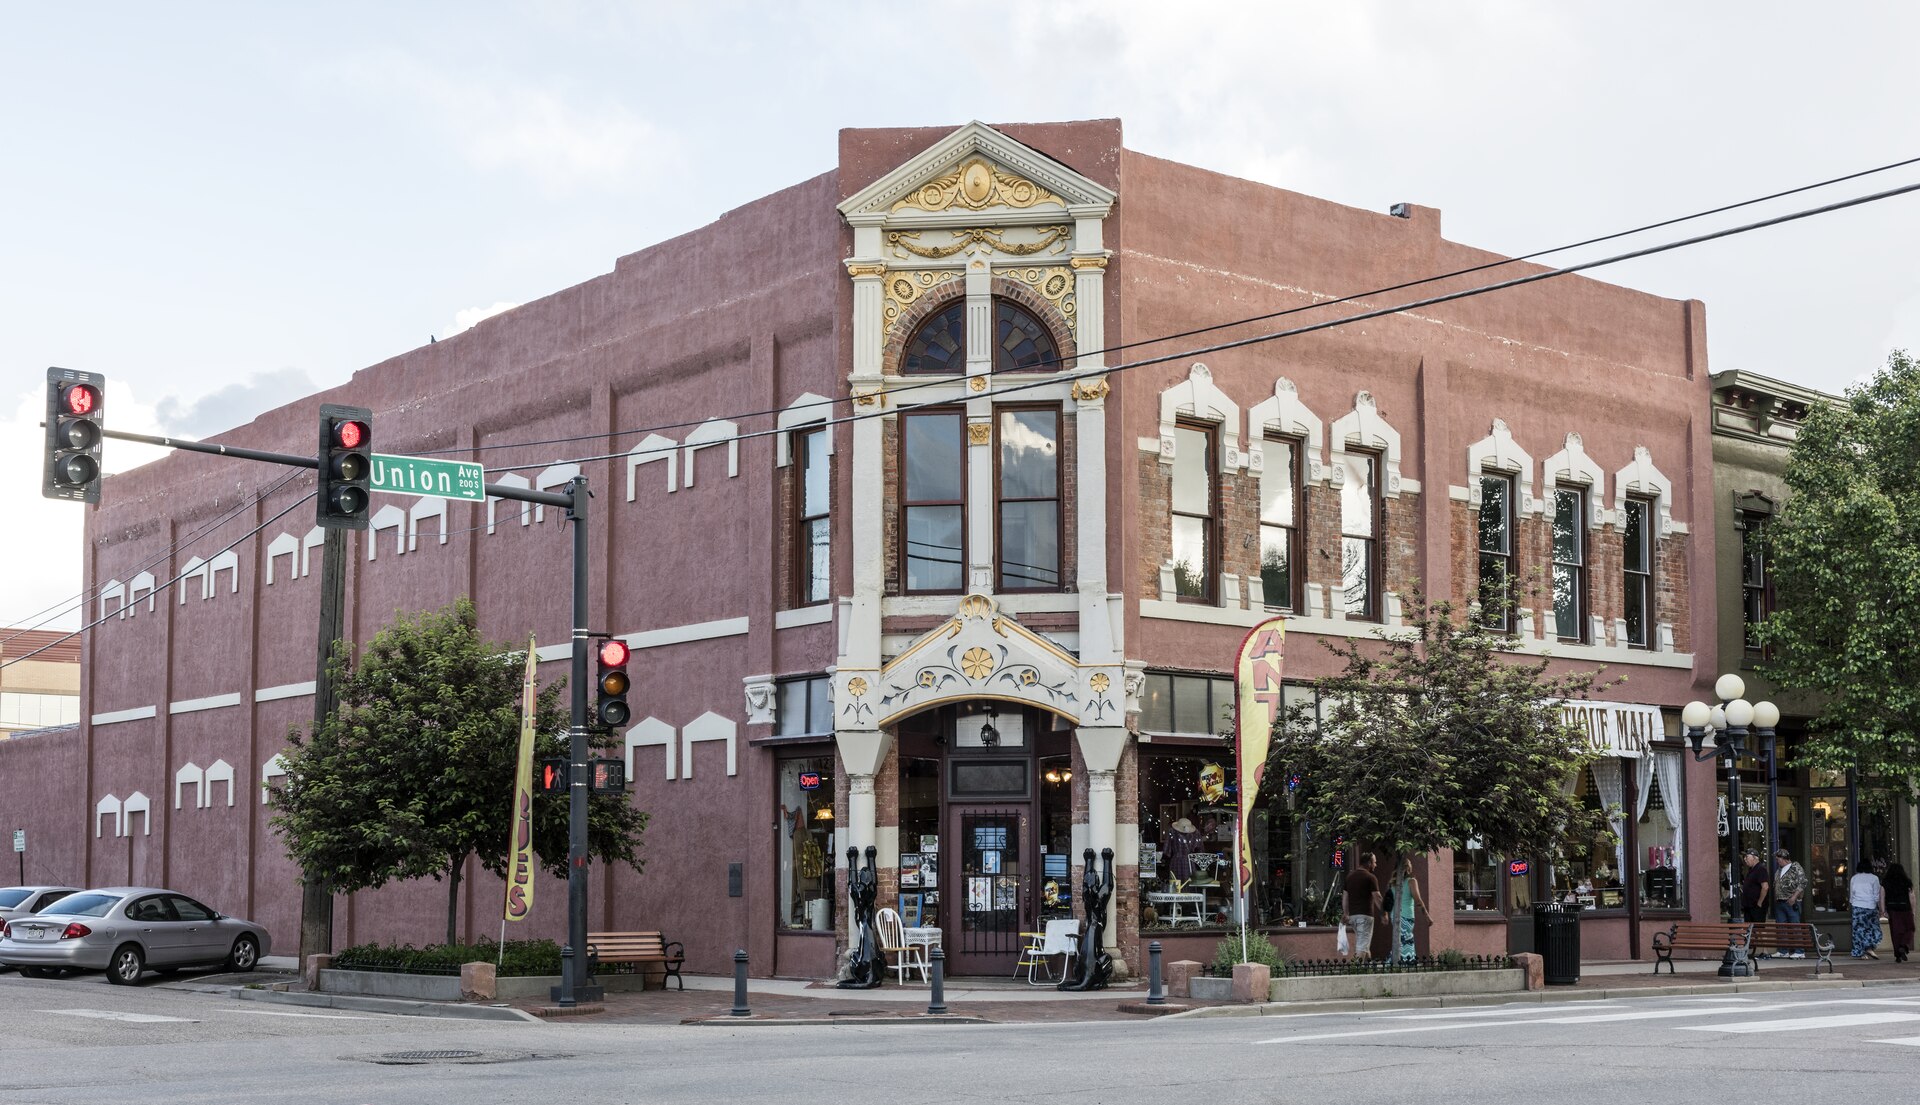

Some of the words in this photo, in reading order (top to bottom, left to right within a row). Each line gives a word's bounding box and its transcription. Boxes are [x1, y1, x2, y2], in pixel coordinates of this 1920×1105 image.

[371, 461, 451, 492] Union
[458, 465, 479, 479] Ave
[459, 480, 473, 489] 200
[801, 775, 818, 787] Open
[1511, 862, 1527, 874] Open
